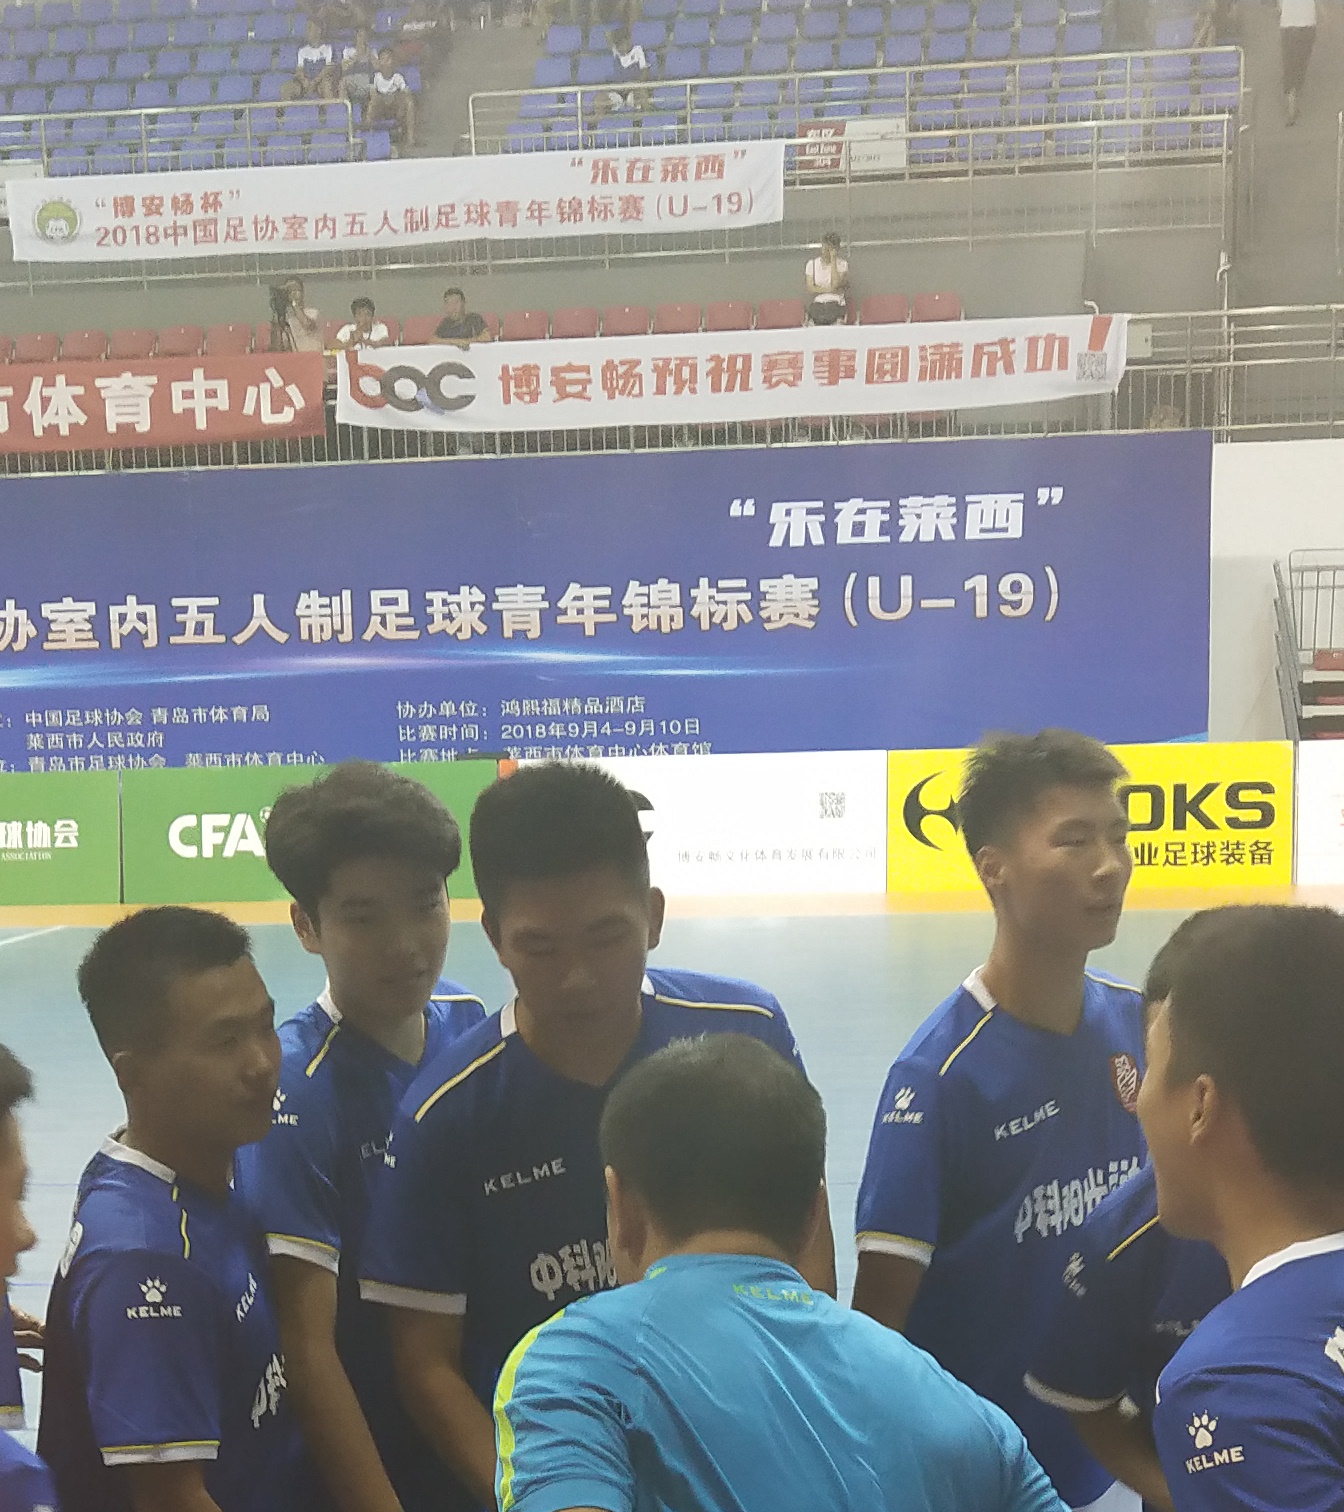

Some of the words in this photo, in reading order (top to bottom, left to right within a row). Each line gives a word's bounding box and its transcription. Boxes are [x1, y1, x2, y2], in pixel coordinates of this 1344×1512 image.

[729, 487, 1064, 548] “乐在莱西”
[25, 707, 144, 728] 中国足球协会
[150, 704, 271, 725] 青岛市体育局
[26, 731, 165, 750] 莱西市人民政府
[168, 812, 266, 858] CFA
[994, 1100, 1060, 1142] KELME
[483, 1157, 567, 1196] KELME
[732, 1284, 815, 1306] KELME
[126, 1304, 182, 1320] KELME
[1185, 1446, 1245, 1474] KELME
